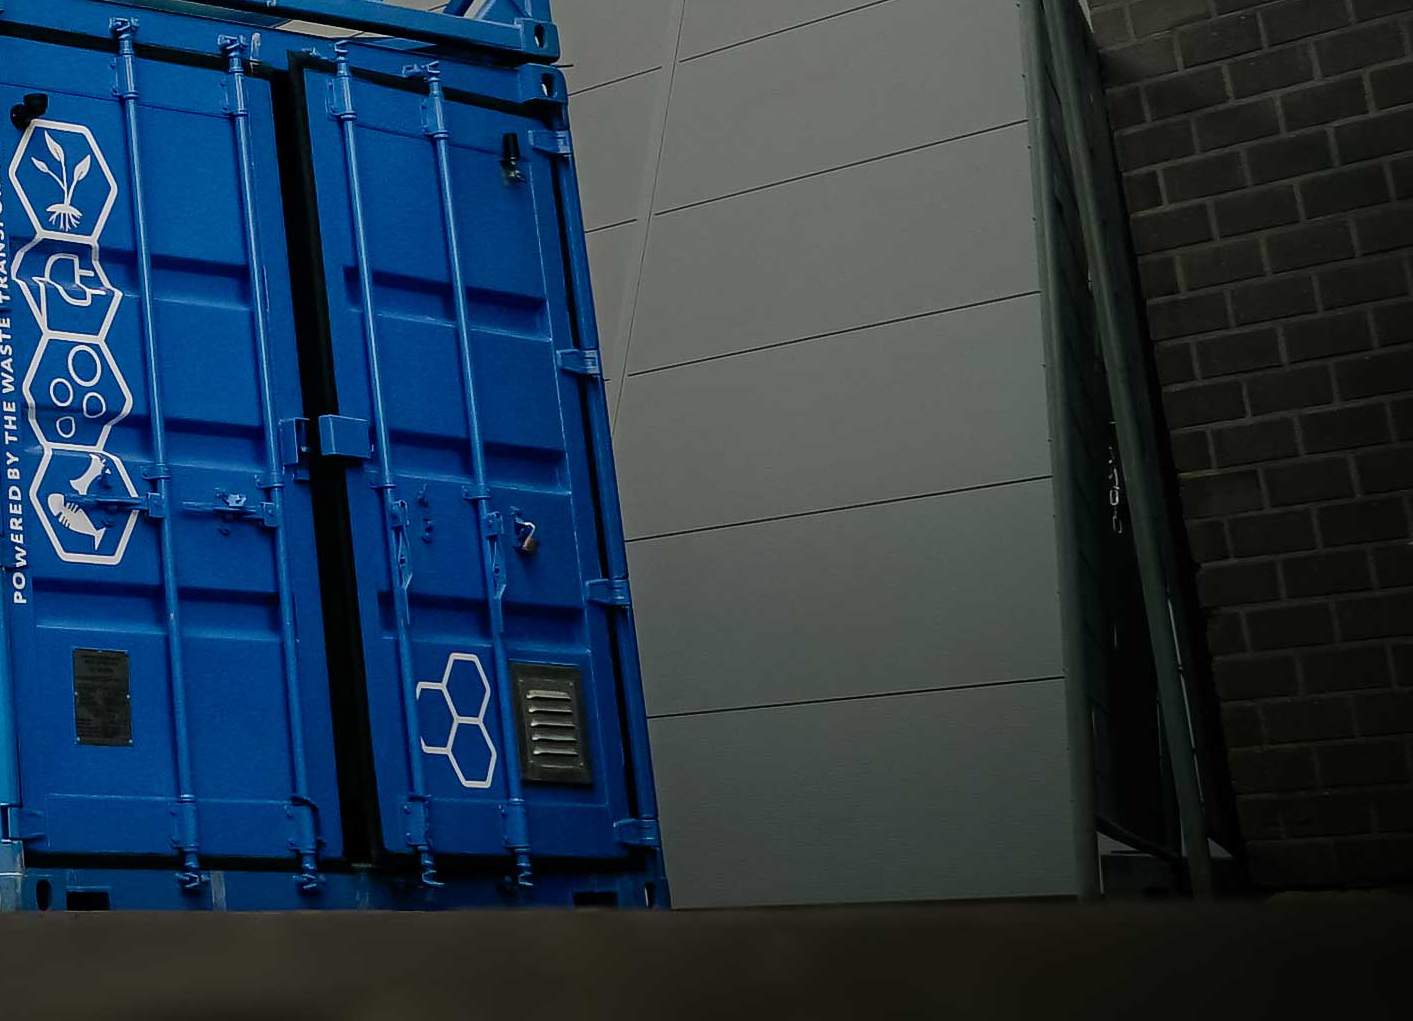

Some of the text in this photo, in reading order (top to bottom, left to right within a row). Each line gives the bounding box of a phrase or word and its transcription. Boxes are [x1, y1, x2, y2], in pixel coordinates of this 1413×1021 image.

[1, 399, 18, 445] THE
[4, 450, 22, 481] BY
[7, 483, 27, 605] POWERED
